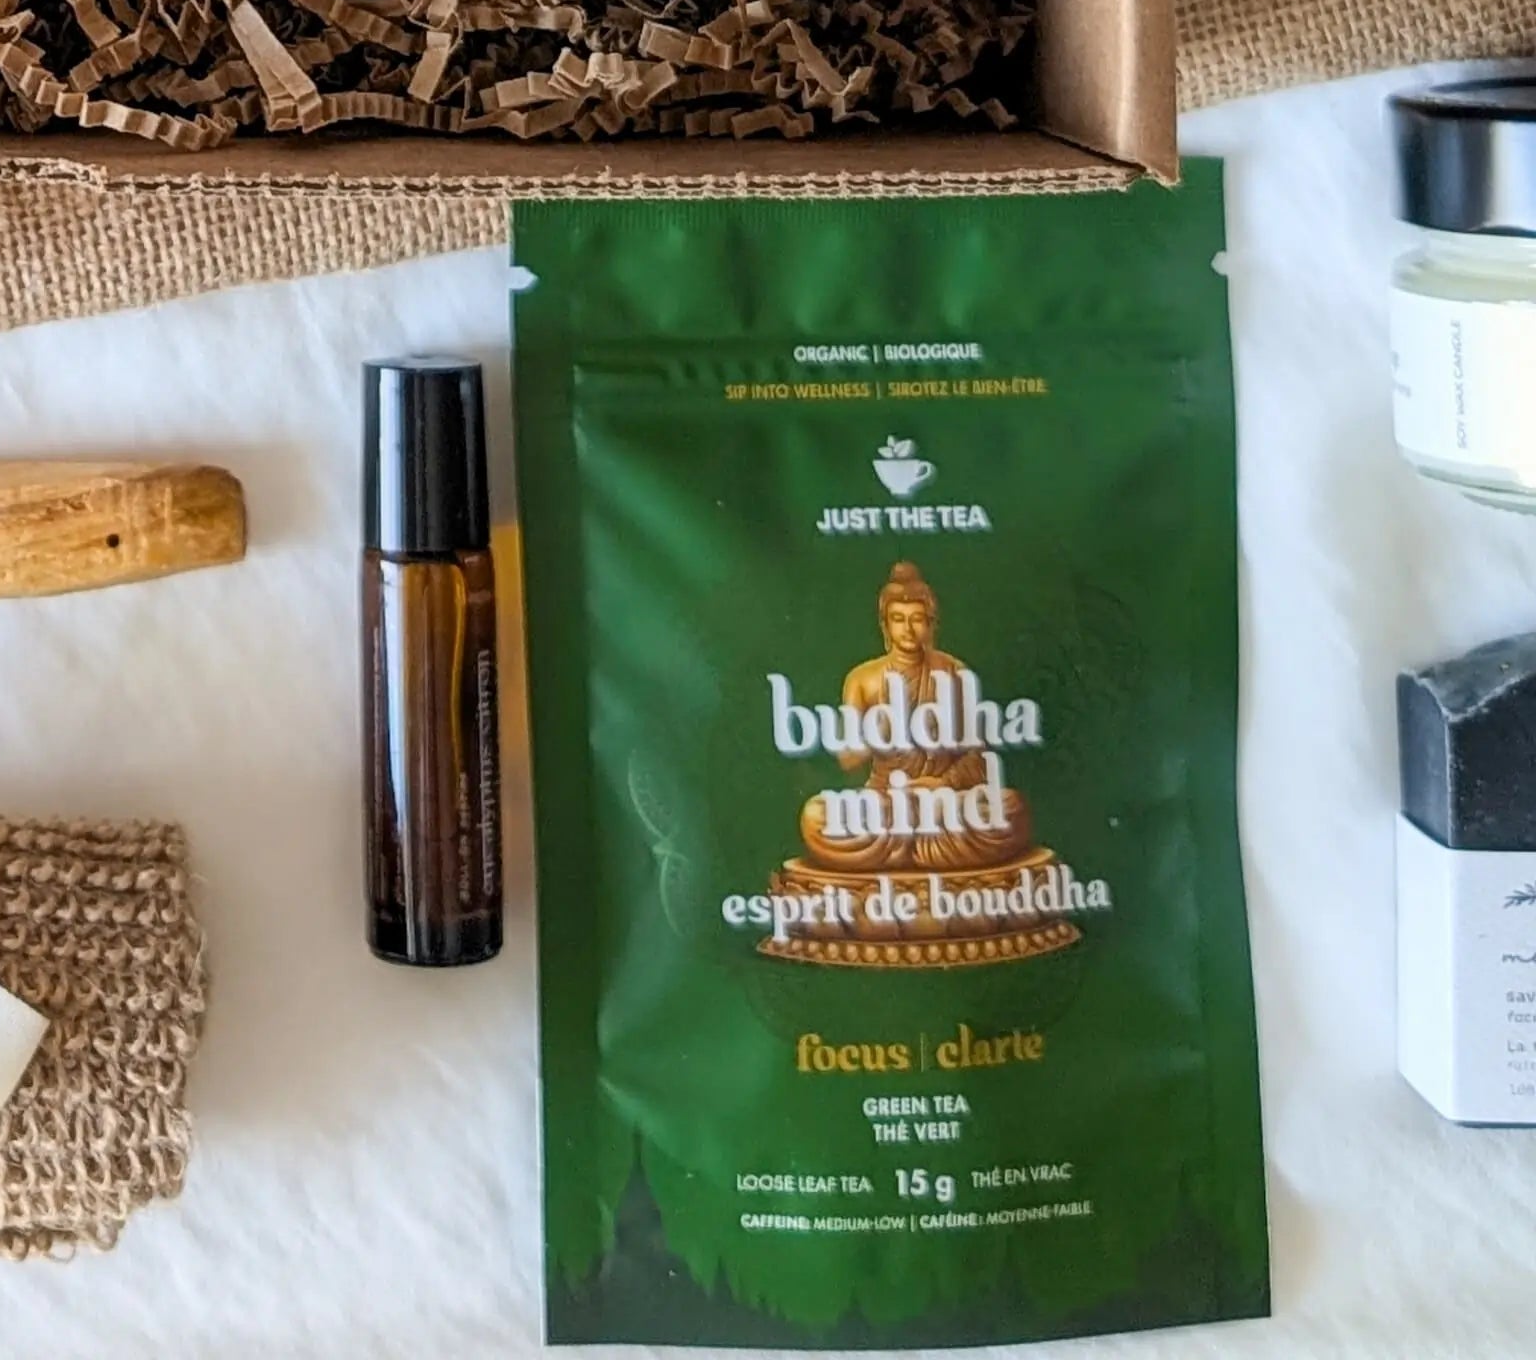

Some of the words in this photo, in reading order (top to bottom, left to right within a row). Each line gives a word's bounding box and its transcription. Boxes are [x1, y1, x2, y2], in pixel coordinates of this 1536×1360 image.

[817, 508, 882, 532] JUST
[885, 507, 935, 529] THE
[937, 505, 991, 529] TEA
[767, 668, 1043, 754] buddha
[821, 752, 1010, 837] mind
[722, 885, 854, 942] esprit
[864, 875, 917, 922] de
[929, 864, 1112, 921] bouddha
[797, 1033, 911, 1072] focus
[936, 1024, 1045, 1069] clarté
[863, 1097, 928, 1116] GREEN
[934, 1095, 970, 1114] TEA
[873, 1119, 907, 1142] THÉ
[914, 1122, 959, 1141] VERT
